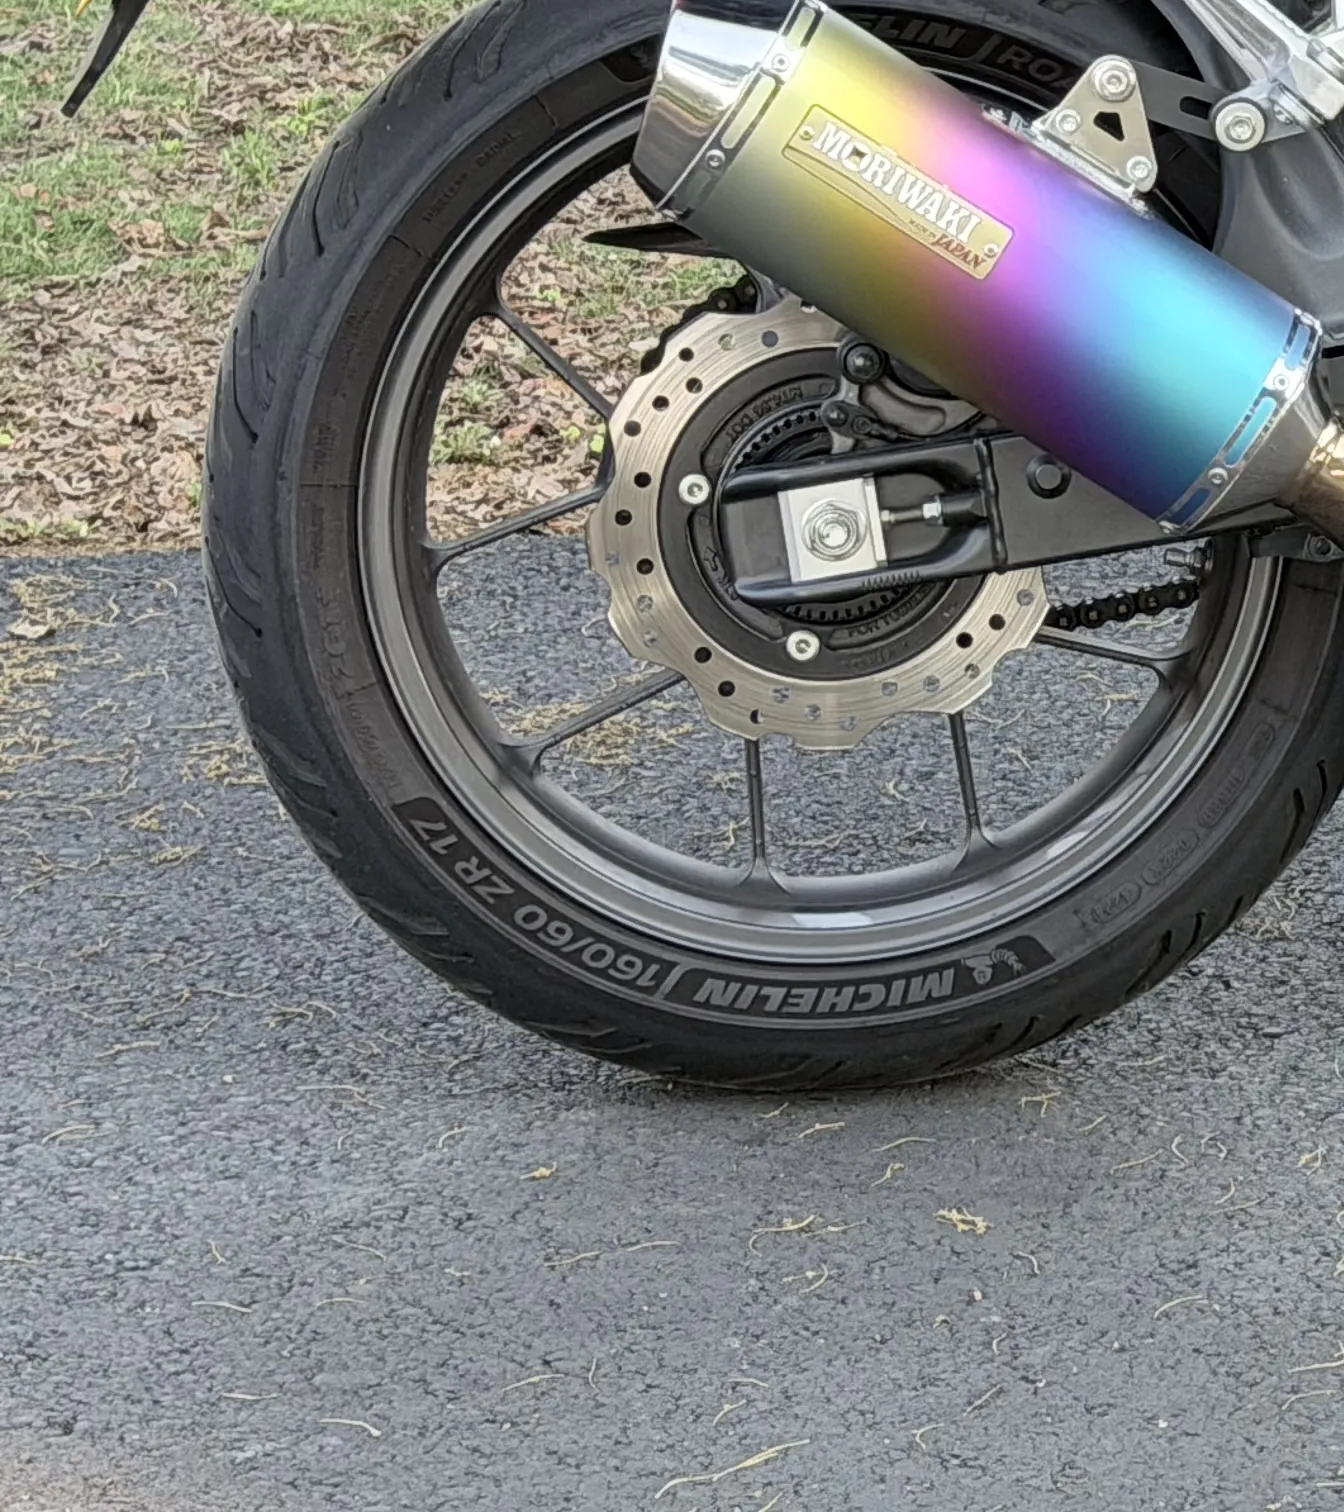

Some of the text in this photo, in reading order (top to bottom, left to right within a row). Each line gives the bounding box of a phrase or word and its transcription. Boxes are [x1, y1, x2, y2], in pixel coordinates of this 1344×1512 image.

[813, 121, 981, 243] MORIWAKI
[930, 233, 987, 270] JAPAN
[408, 818, 662, 988] 160/60 ZR 17
[693, 967, 955, 1014] MICHELIN
